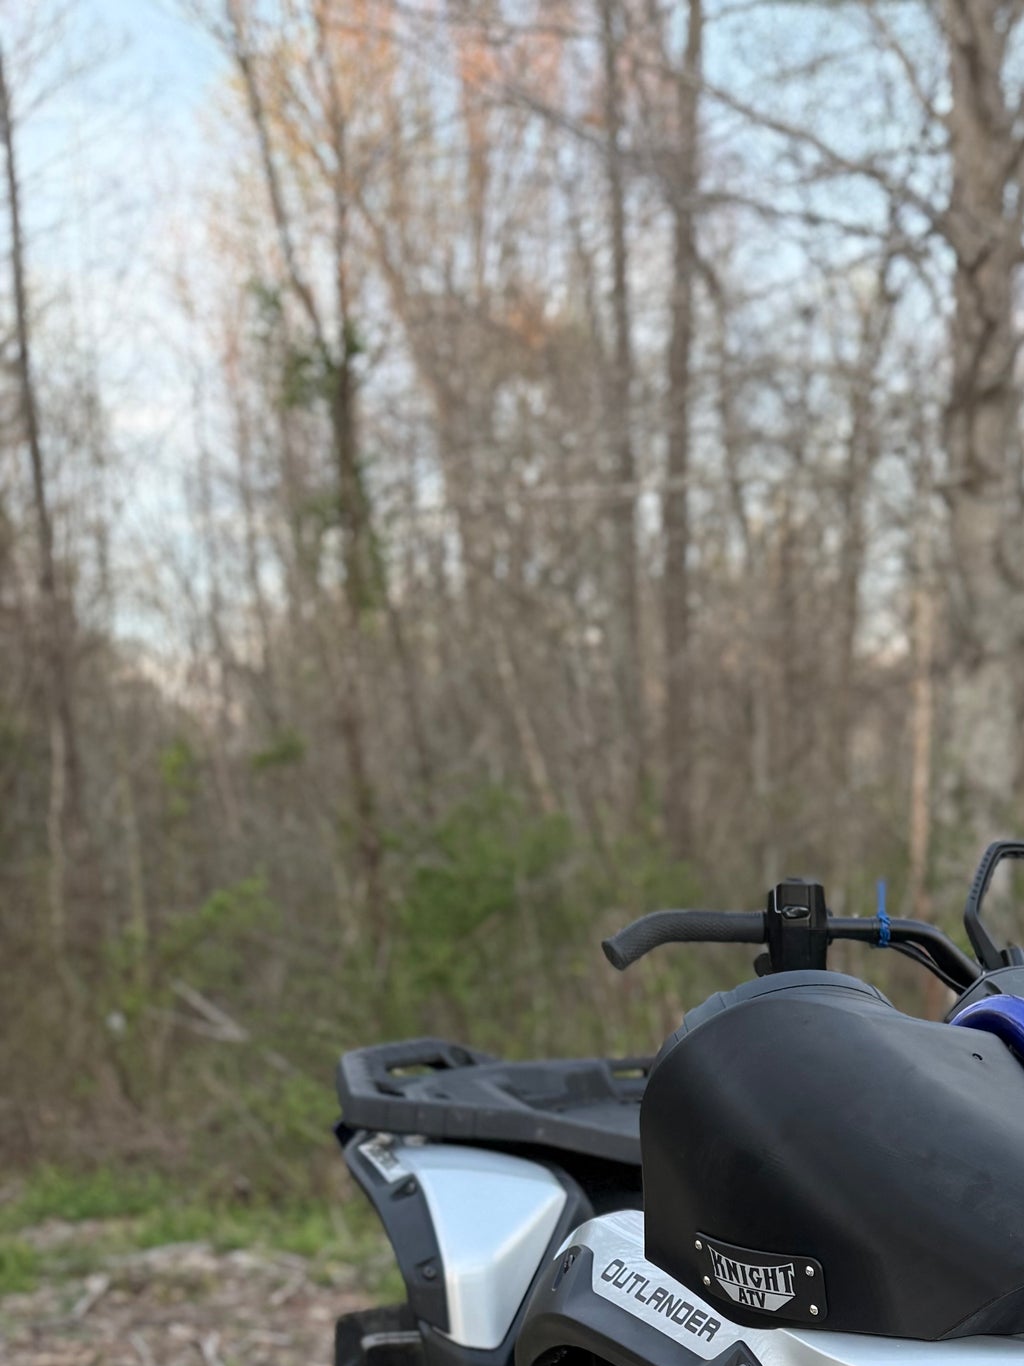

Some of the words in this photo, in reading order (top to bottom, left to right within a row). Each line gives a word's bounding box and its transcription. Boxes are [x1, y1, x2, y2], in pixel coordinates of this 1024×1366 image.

[708, 1246, 796, 1295] KNIGHT
[600, 1258, 722, 1342] OUTLANDER
[738, 1287, 766, 1309] ATV
